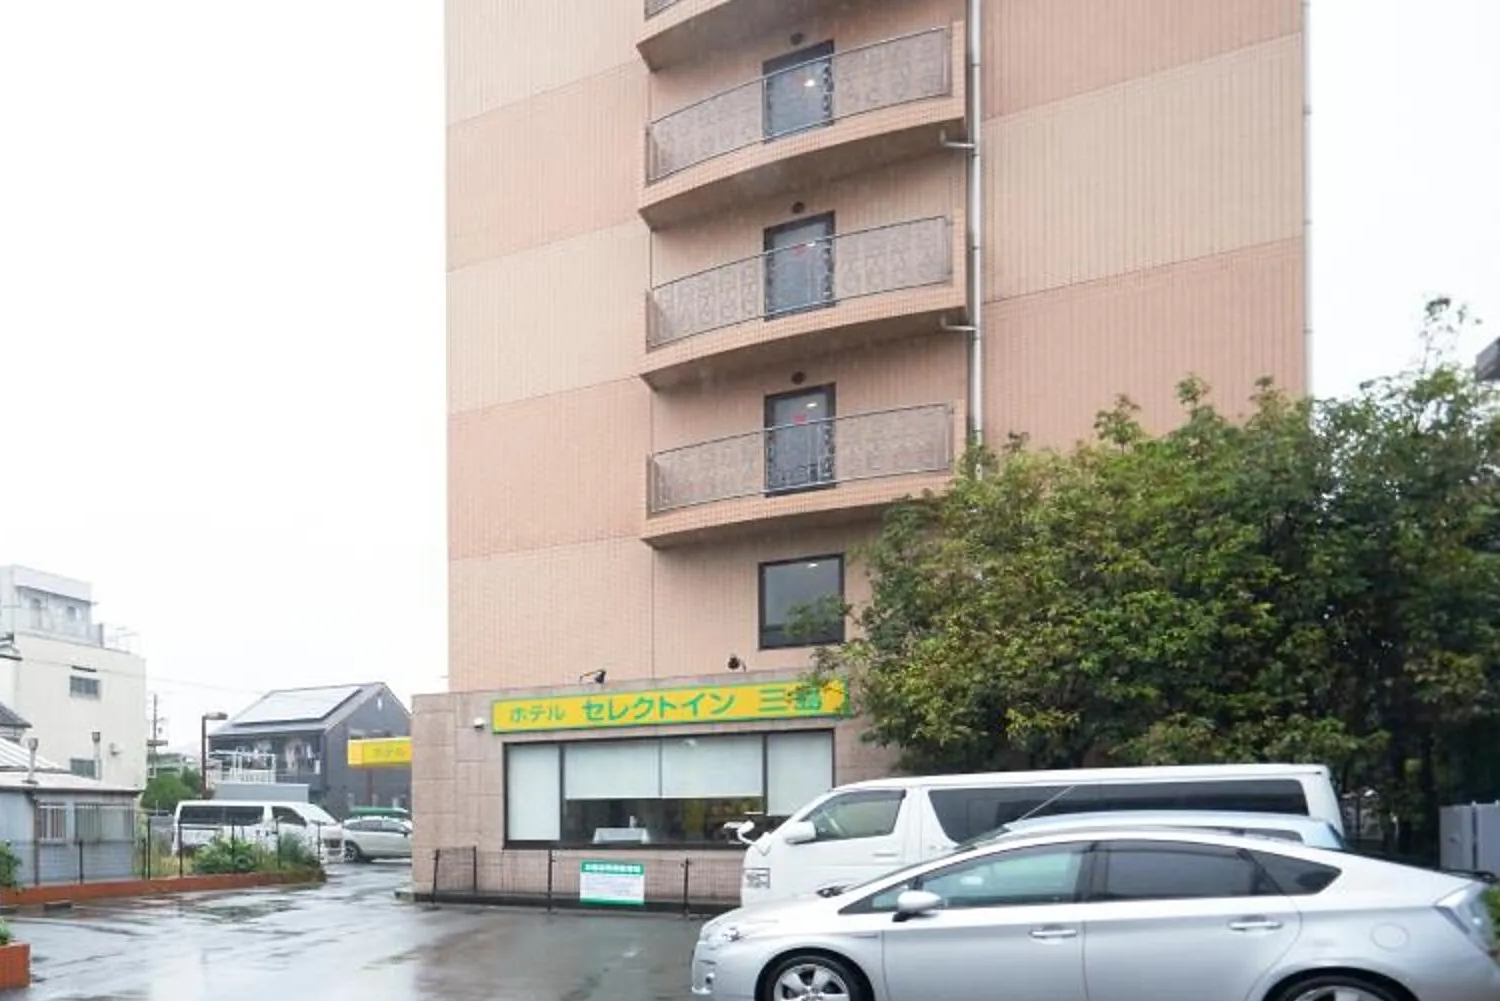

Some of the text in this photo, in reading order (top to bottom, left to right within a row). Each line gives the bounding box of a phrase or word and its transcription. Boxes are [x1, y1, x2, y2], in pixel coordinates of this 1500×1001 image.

[510, 703, 566, 723] ホテル
[582, 692, 735, 721] セレクトイン
